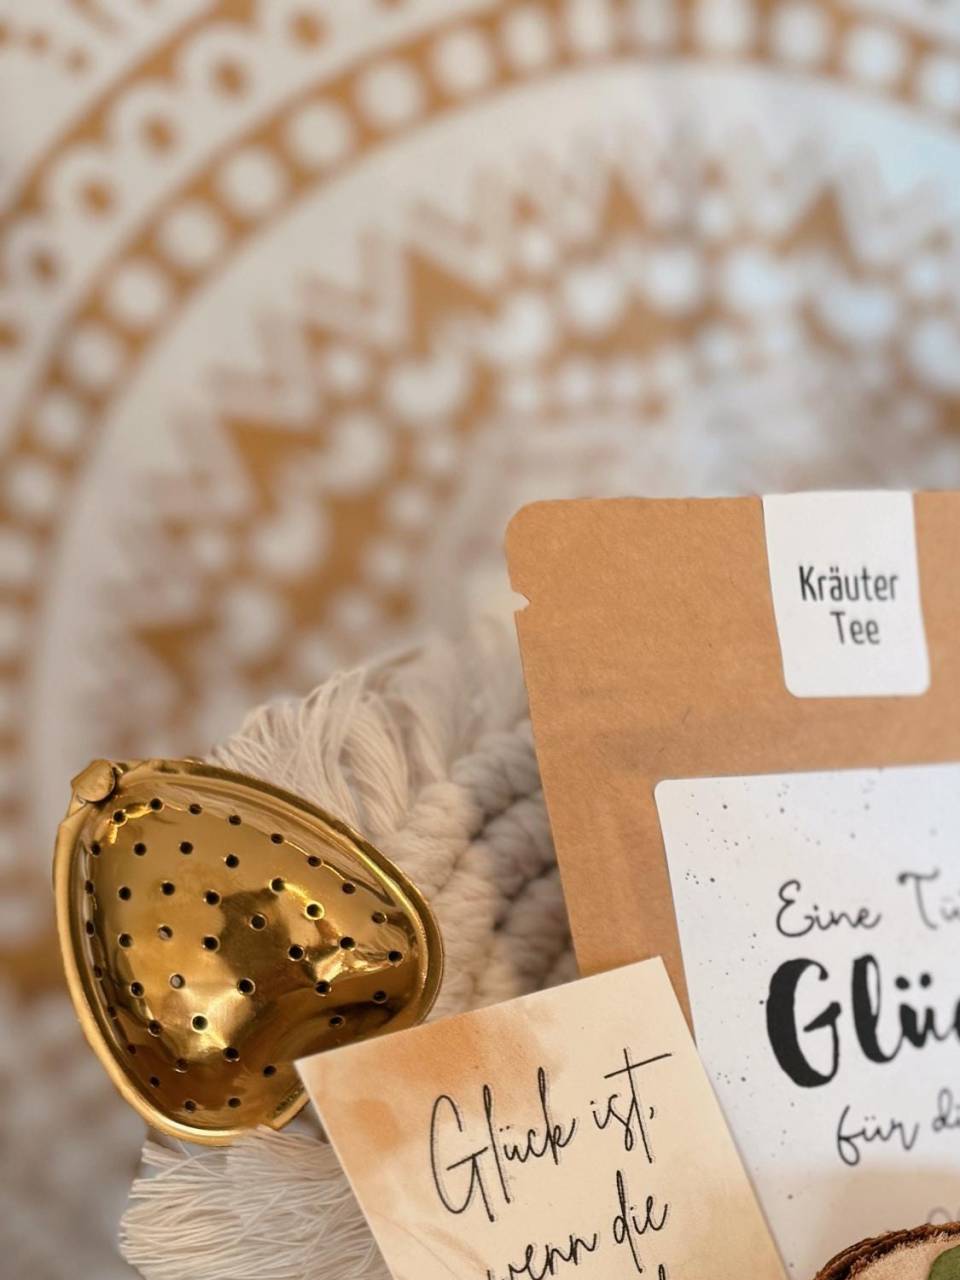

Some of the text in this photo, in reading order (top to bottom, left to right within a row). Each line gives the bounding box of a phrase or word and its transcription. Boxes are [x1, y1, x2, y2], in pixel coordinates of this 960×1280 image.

[799, 565, 898, 602] Kräuter
[829, 611, 881, 645] Tee
[776, 879, 881, 937] Eine
[431, 1048, 672, 1222] Glück ist,
[836, 1105, 919, 1166] für
[613, 1170, 668, 1273] die
